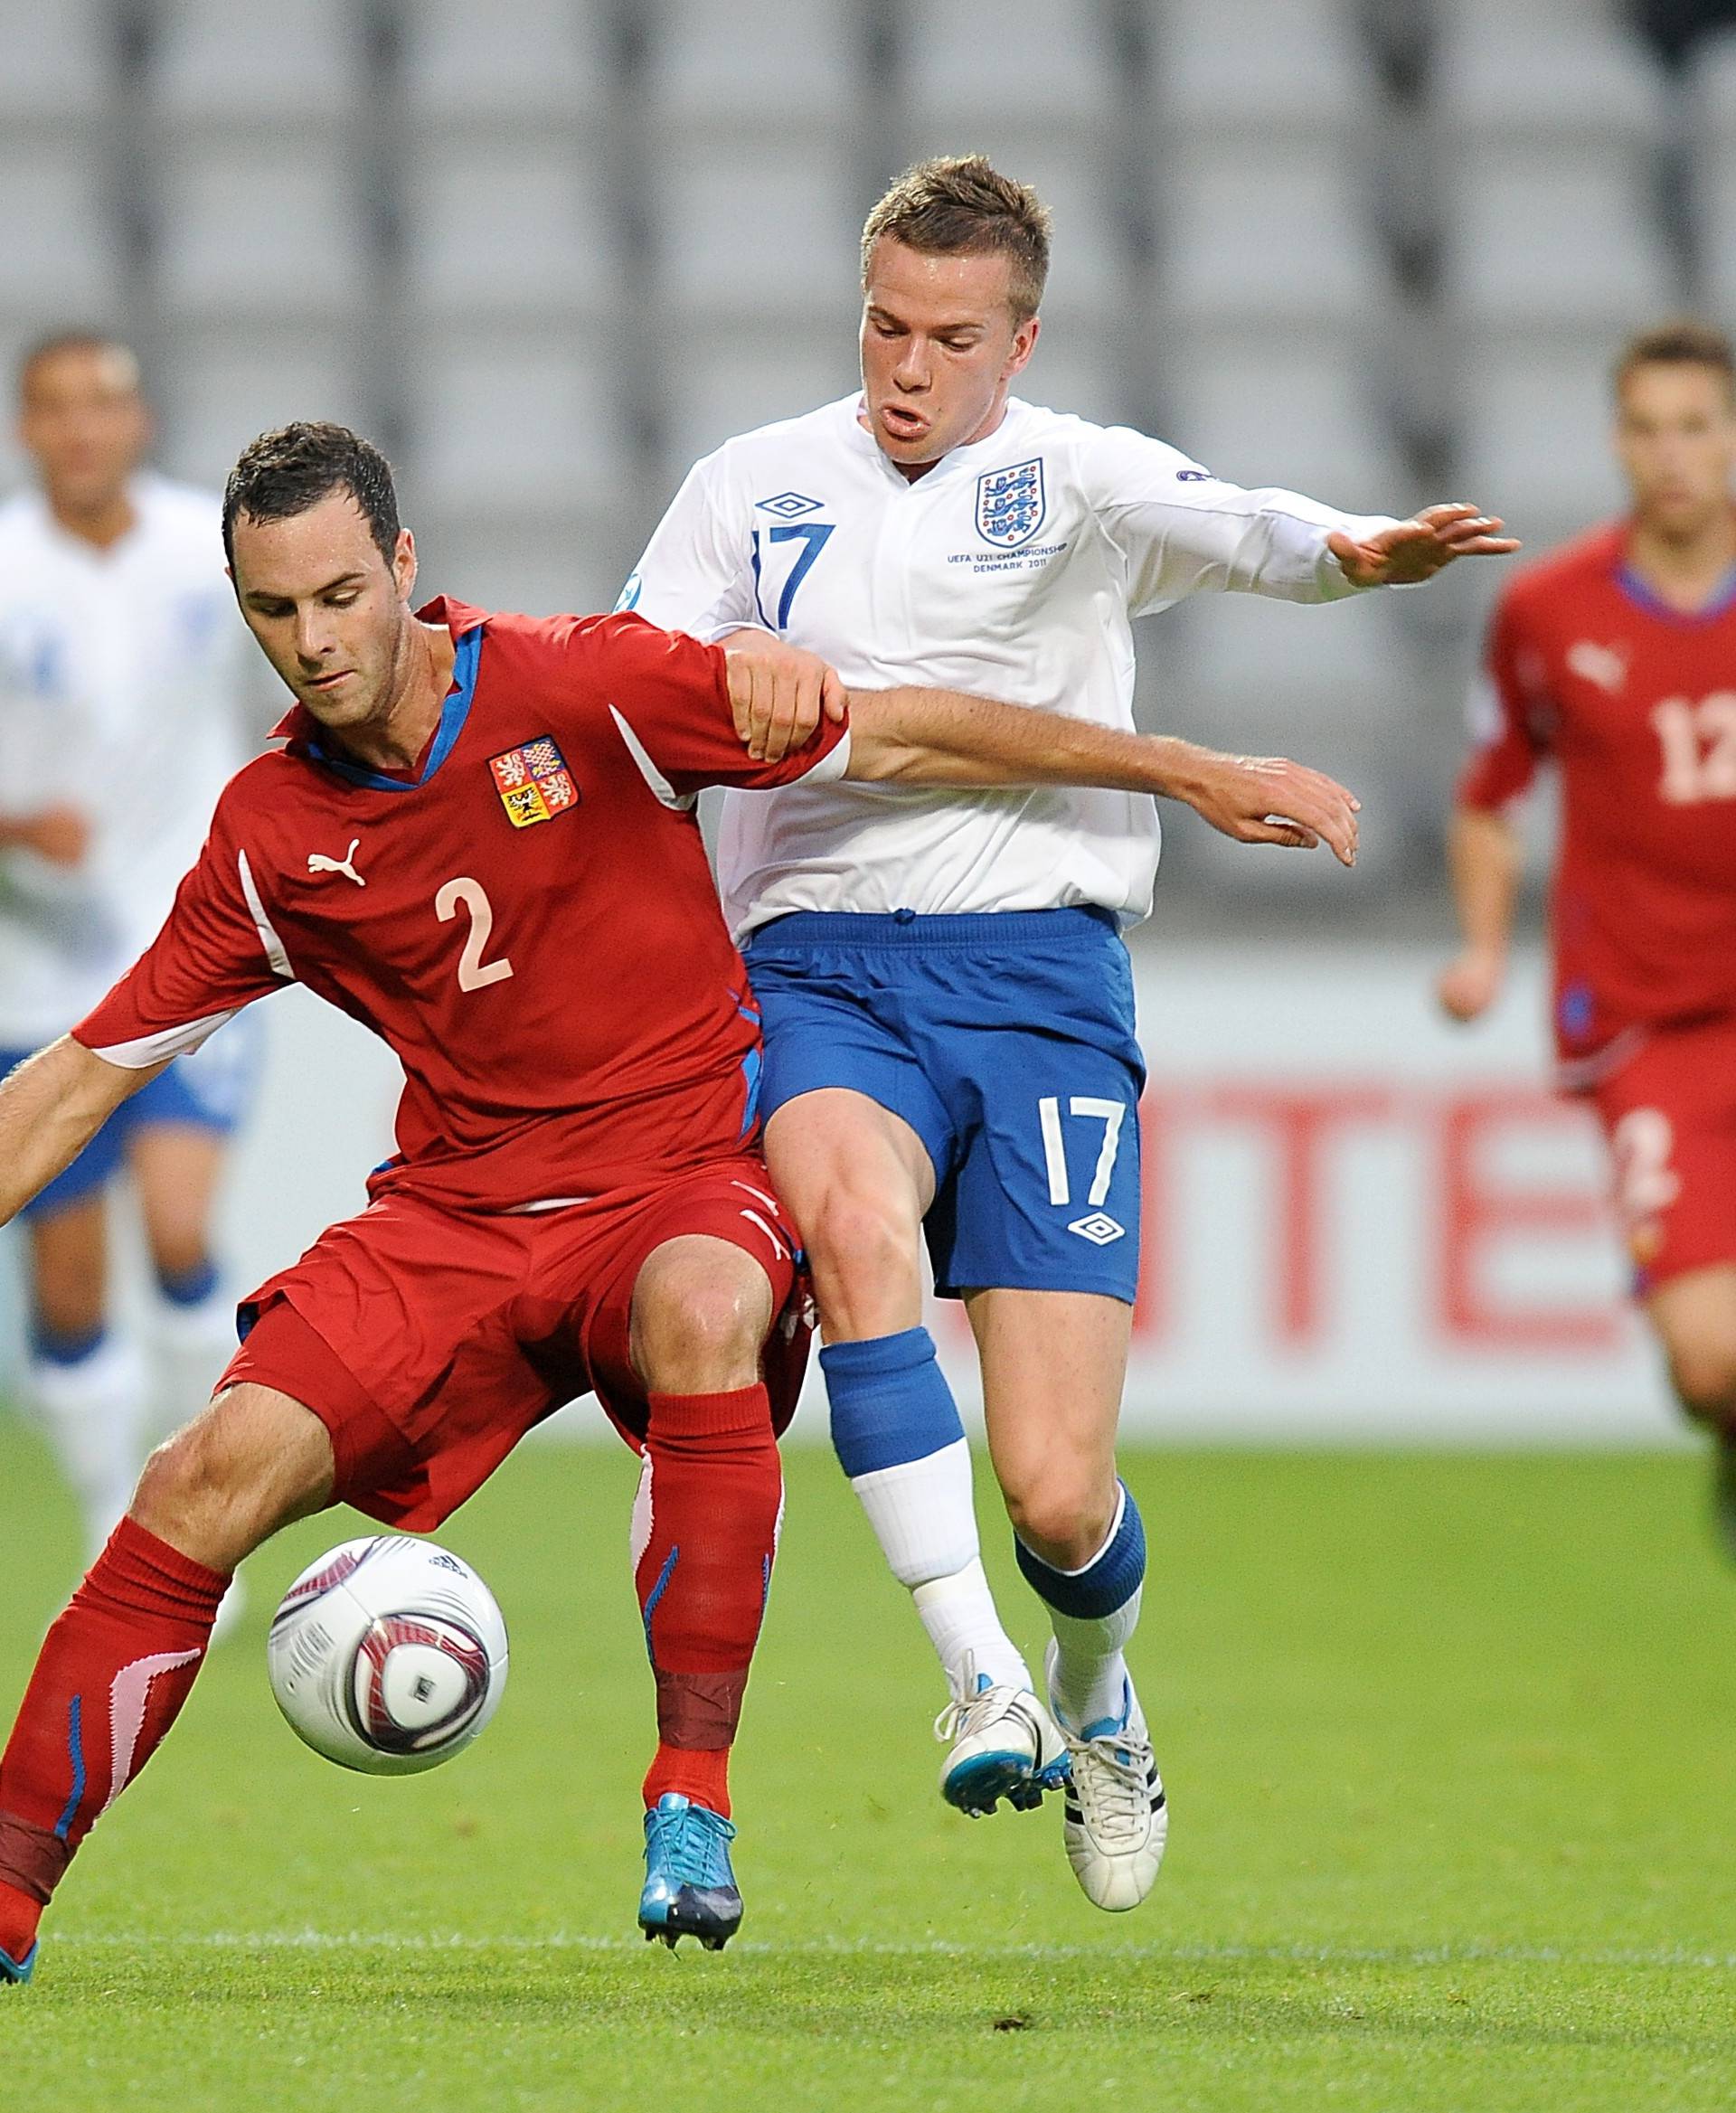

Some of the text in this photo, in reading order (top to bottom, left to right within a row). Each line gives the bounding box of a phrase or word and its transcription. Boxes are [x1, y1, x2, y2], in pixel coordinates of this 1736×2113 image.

[947, 554, 971, 563] UEFA
[976, 553, 993, 562] U21
[973, 559, 1047, 573] DENMARK 2011
[435, 876, 514, 993] 2
[1039, 1096, 1127, 1207] 17
